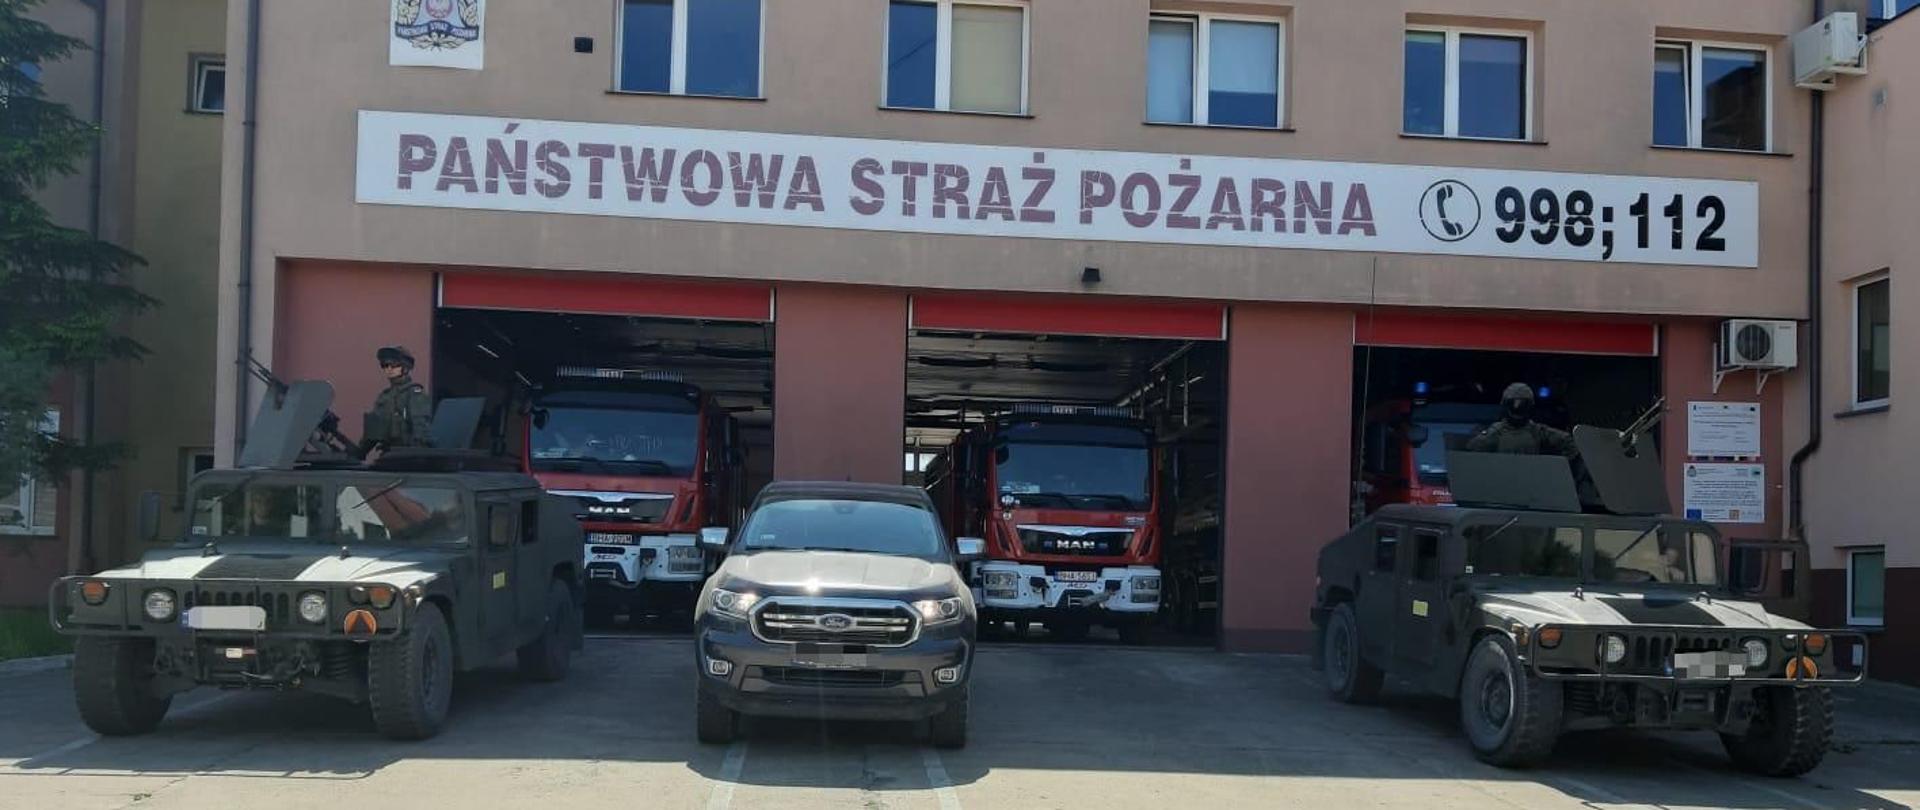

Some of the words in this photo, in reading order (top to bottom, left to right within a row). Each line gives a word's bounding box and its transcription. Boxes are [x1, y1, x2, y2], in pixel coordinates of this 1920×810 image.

[398, 123, 825, 212] PAŃSTWOWA
[849, 151, 1056, 224] STRAŻ
[1079, 158, 1377, 237] POŻARNA
[589, 506, 630, 514] MAN
[1057, 540, 1096, 549] MAN
[825, 616, 849, 628] Ford
